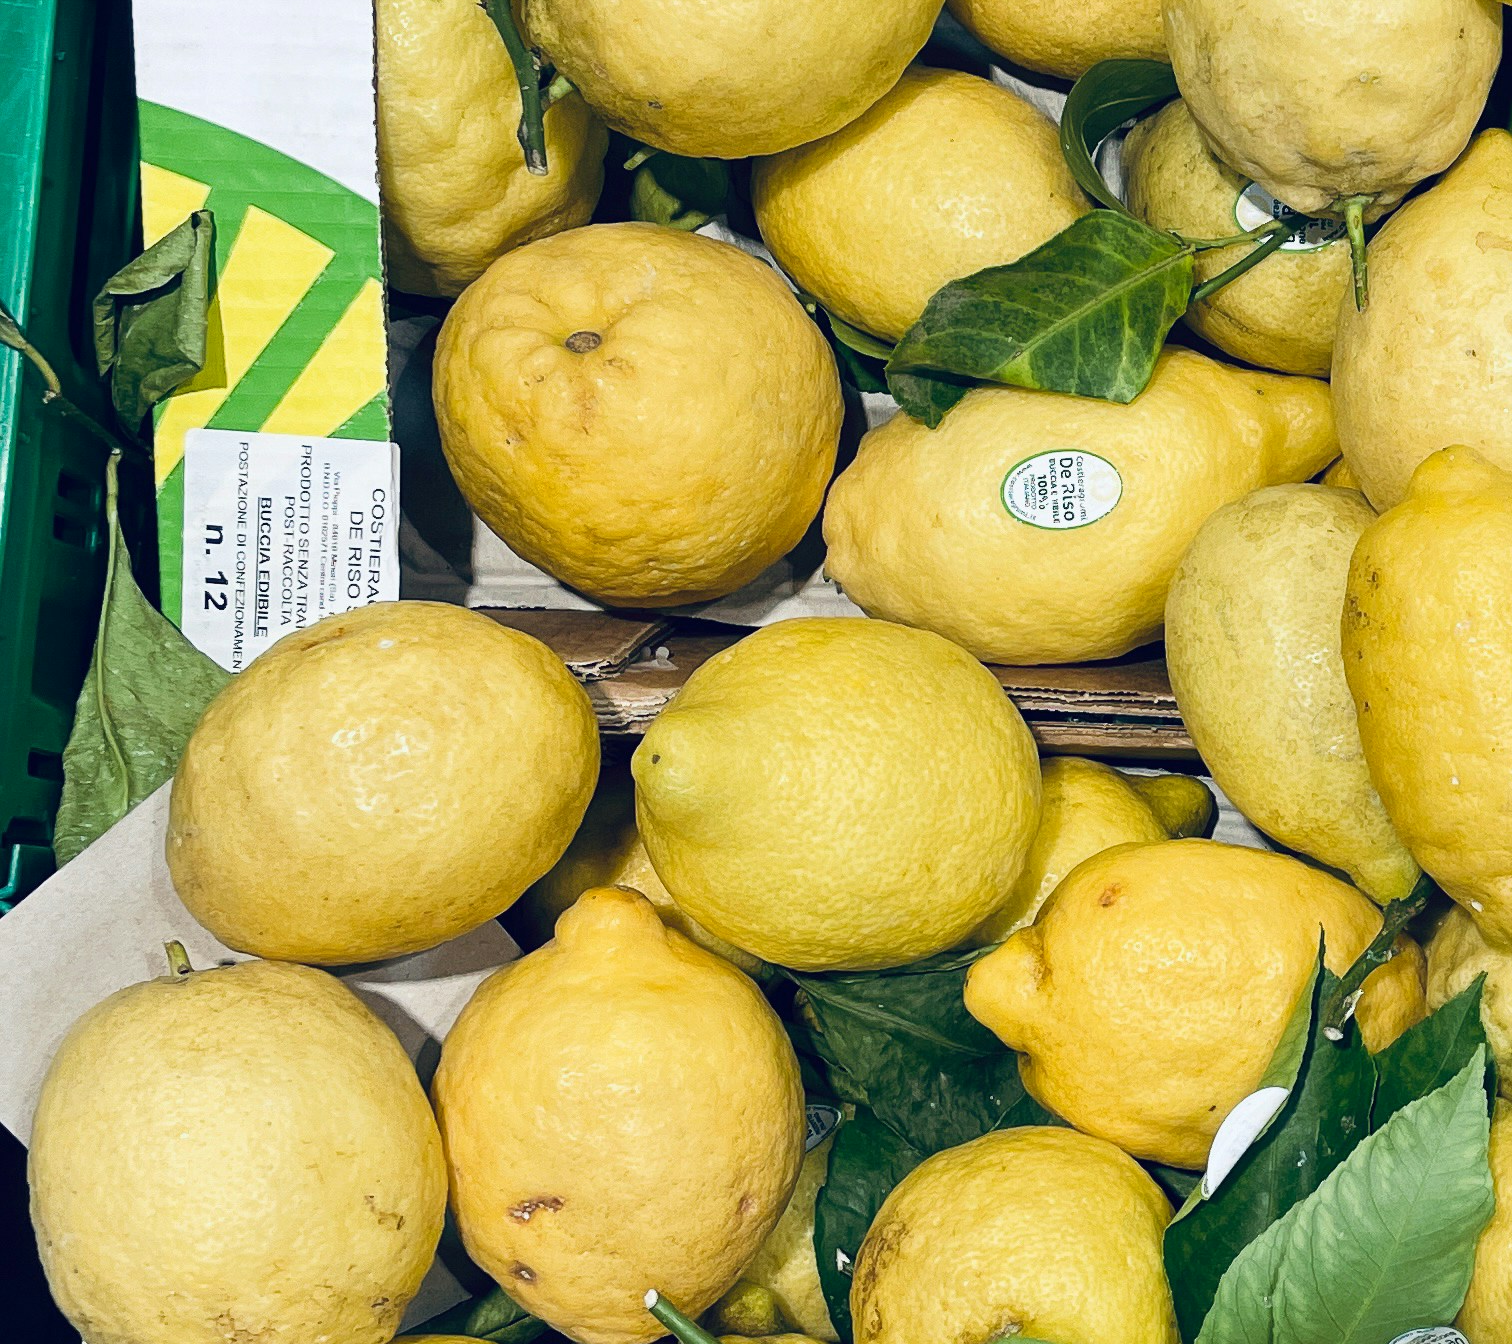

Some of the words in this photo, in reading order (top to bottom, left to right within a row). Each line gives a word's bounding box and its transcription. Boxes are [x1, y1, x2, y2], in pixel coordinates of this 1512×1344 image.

[236, 441, 250, 529] POSTAZIONE
[299, 444, 313, 534] PRODOTTO
[1037, 474, 1049, 510] 100%
[1059, 457, 1074, 479] De
[348, 511, 364, 540] DE
[1061, 483, 1077, 521] Riso
[205, 524, 226, 556] n.
[236, 533, 247, 548] DI
[258, 496, 273, 565] BUCCIA
[366, 488, 386, 606] COSTIERA
[281, 495, 297, 626] POST-RACCOLTA
[296, 537, 310, 590] SENZA
[346, 546, 363, 599] RISO
[203, 570, 229, 612] 12
[231, 552, 247, 672] CONFEZIONAMEN
[255, 570, 270, 638] EDIBILE
